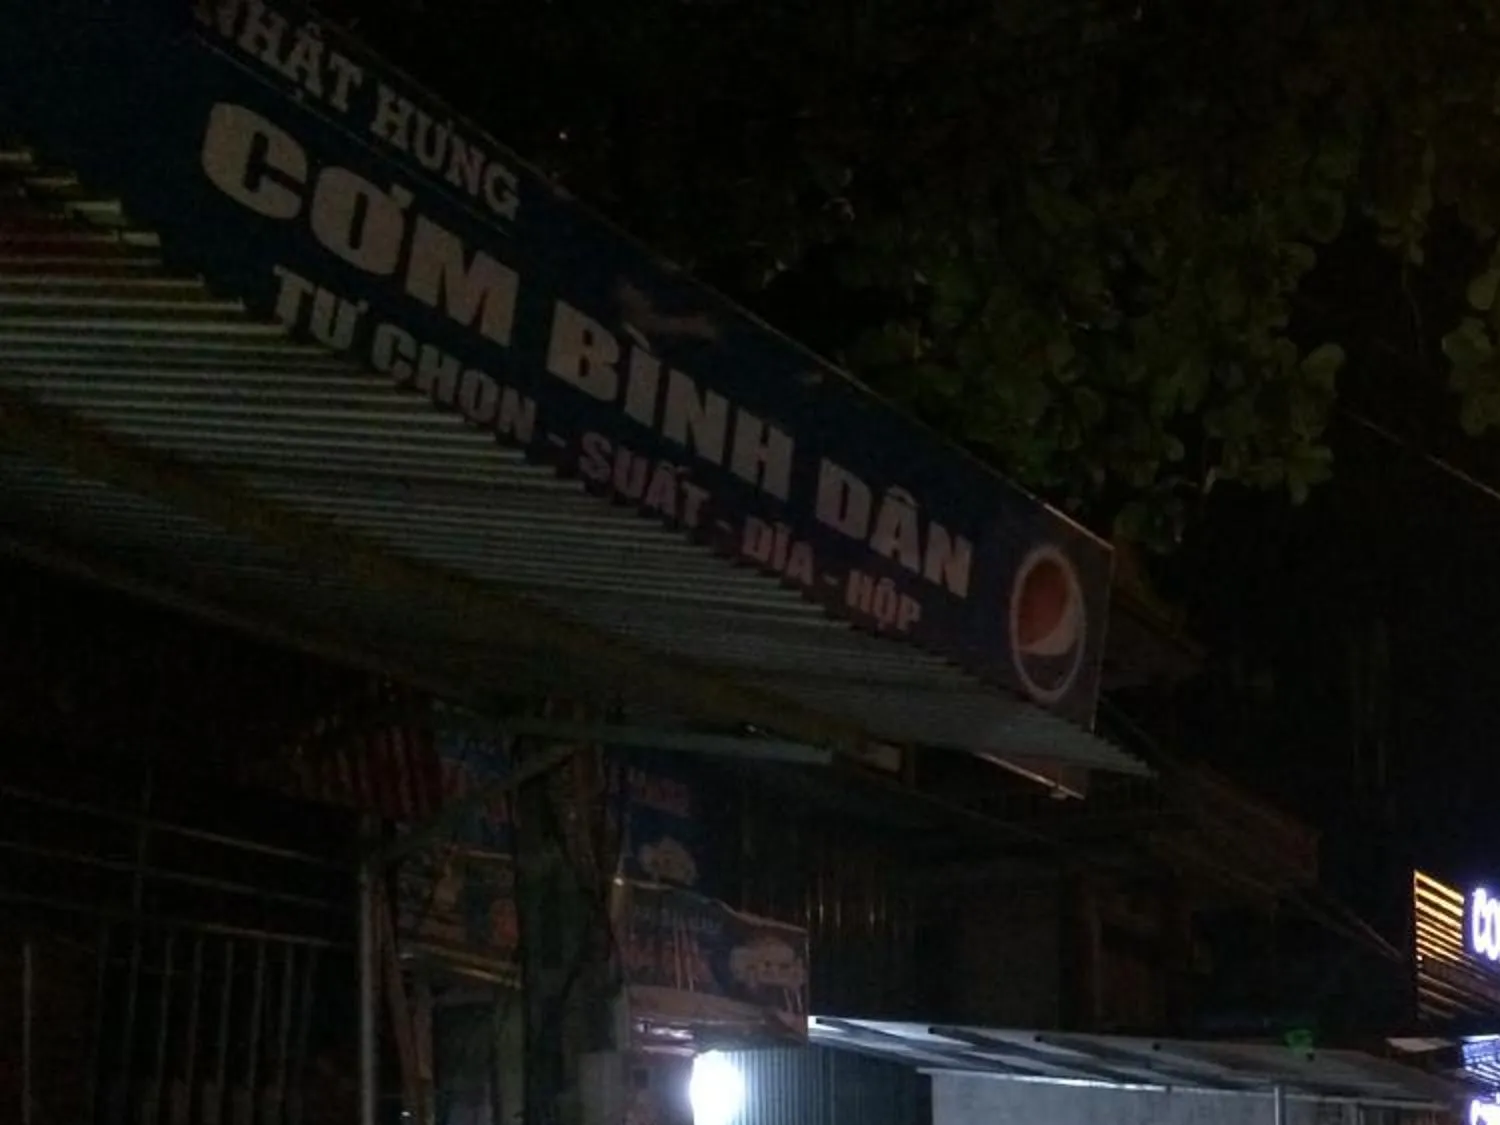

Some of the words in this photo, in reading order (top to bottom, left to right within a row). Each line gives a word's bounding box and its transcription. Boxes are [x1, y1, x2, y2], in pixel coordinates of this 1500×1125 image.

[201, 100, 520, 348] CƠM
[545, 298, 796, 504] BÌNH
[815, 455, 973, 600] DÂN
